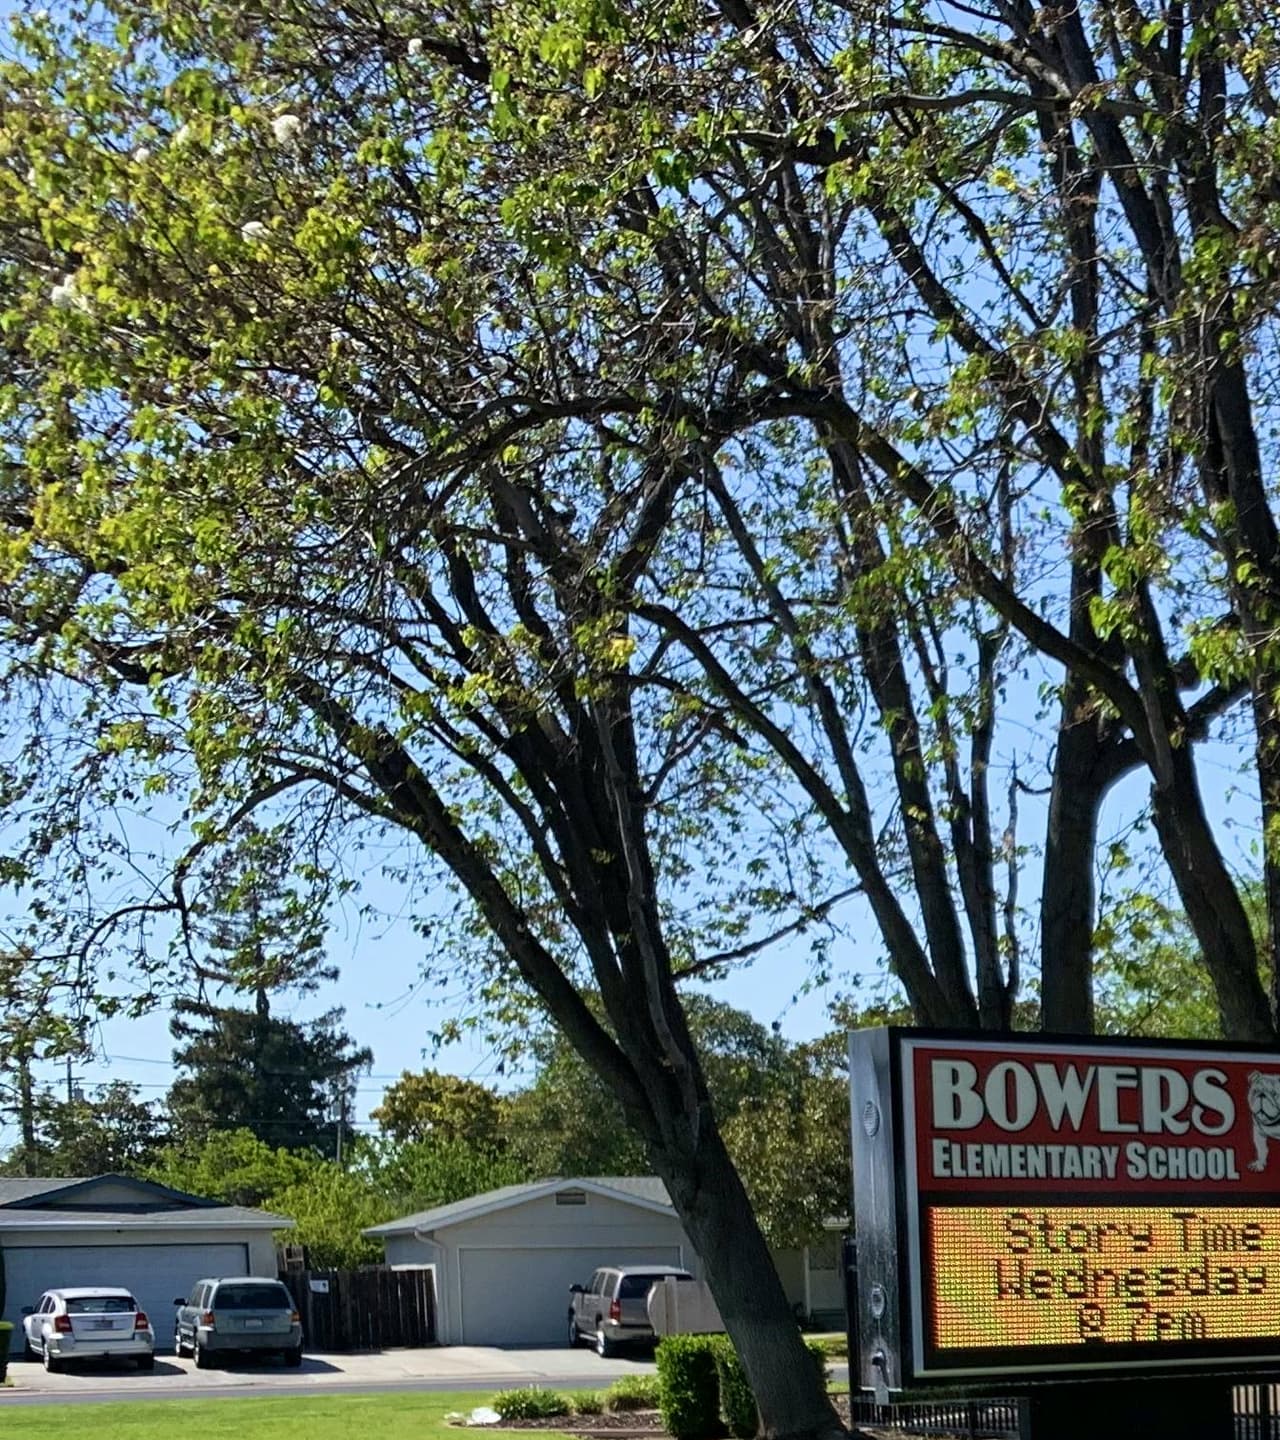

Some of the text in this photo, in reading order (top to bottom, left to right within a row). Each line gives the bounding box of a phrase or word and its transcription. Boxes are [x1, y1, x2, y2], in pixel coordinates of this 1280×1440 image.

[931, 1058, 1235, 1136] BOWERS
[932, 1138, 1240, 1180] ELEMENTARY SCHOOL
[1006, 1211, 1264, 1253] Story Time
[994, 1256, 1267, 1300] Wednesday
